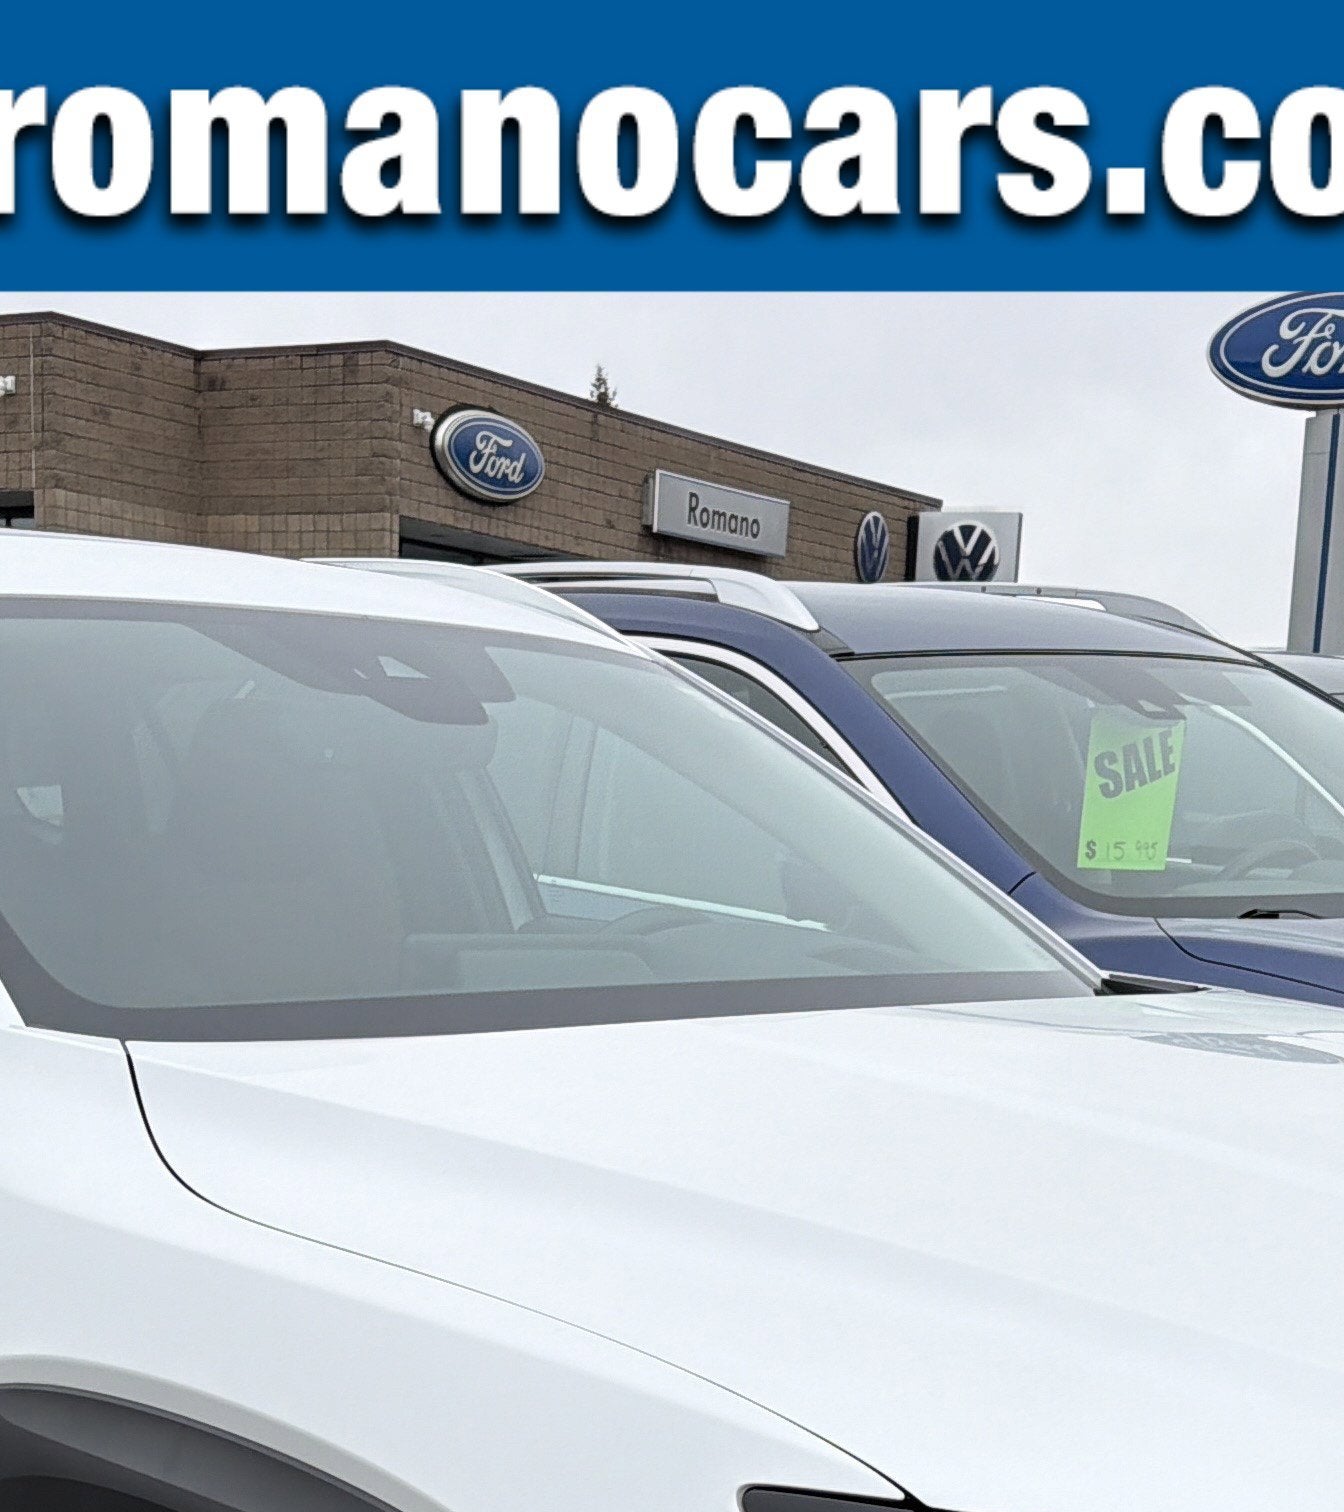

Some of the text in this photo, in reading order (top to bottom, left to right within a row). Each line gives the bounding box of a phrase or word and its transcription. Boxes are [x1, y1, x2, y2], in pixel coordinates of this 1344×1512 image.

[469, 430, 526, 484] Ford
[687, 491, 761, 539] Romano
[1094, 729, 1176, 799] SALE
[1085, 839, 1097, 861] $
